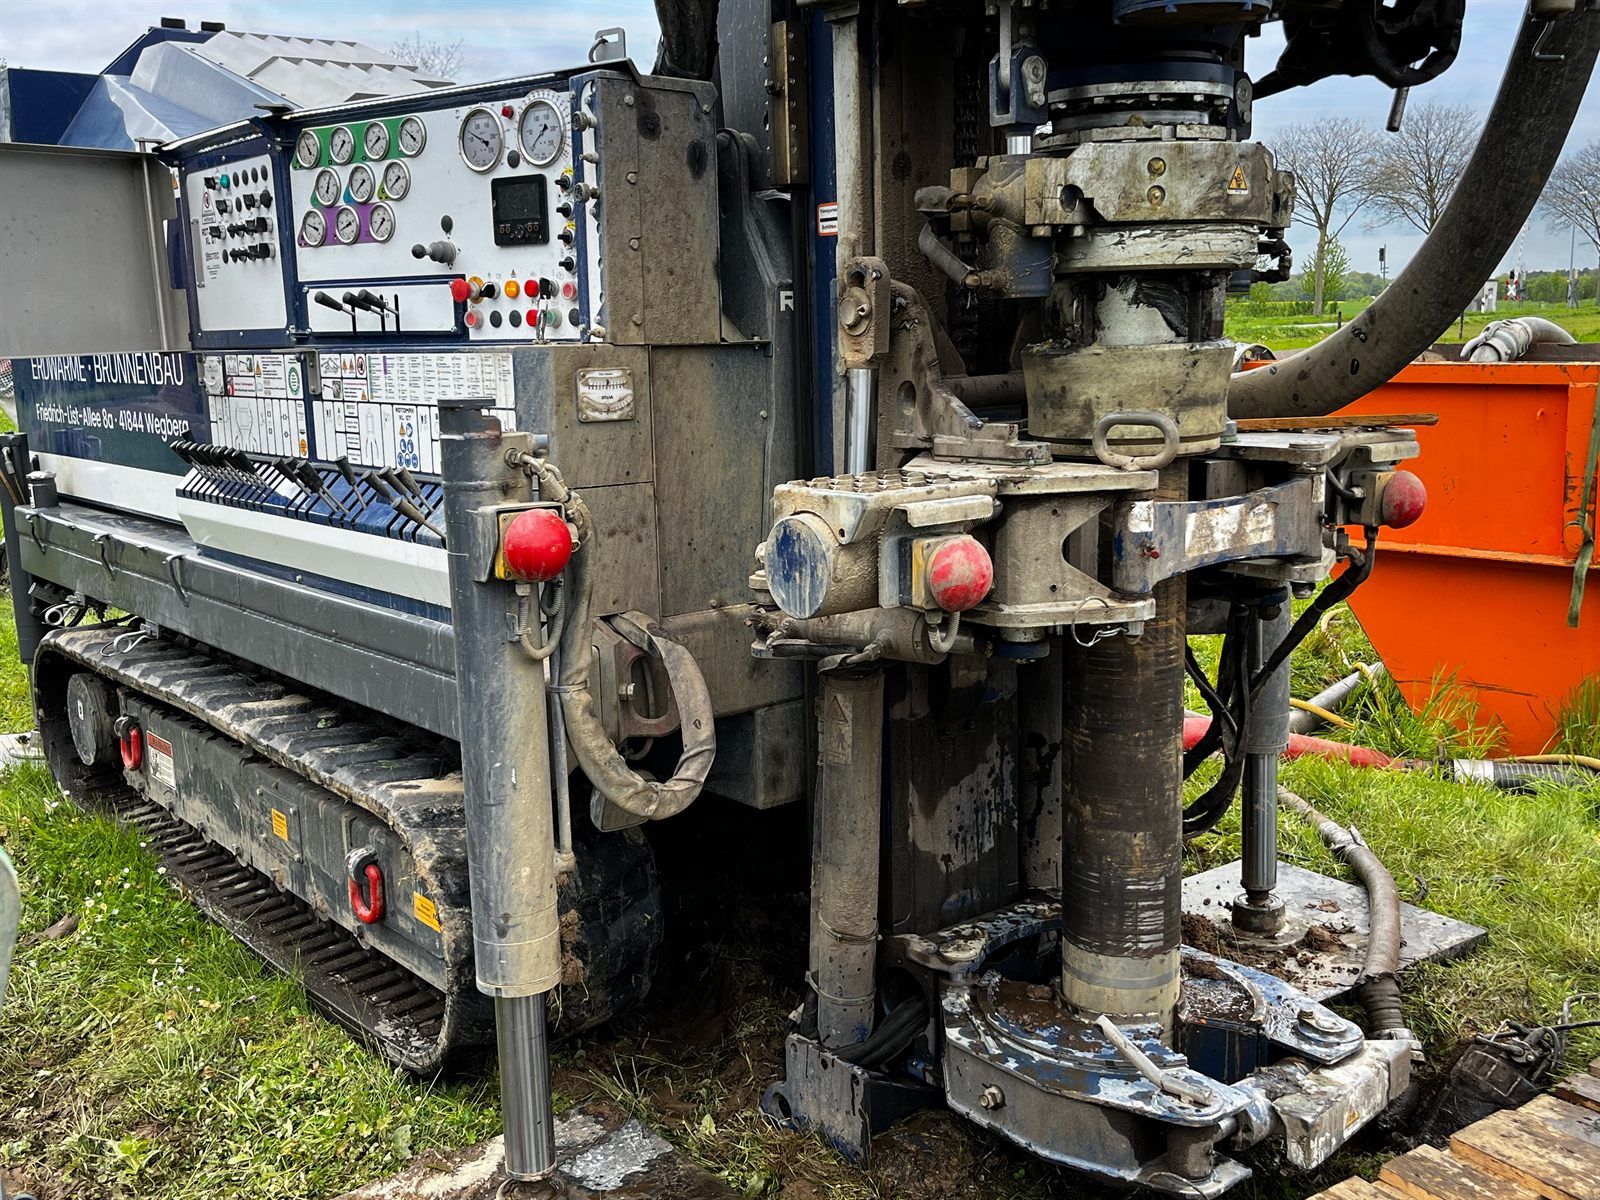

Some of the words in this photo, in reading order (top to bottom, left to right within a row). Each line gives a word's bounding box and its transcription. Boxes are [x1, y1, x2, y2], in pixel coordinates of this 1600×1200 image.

[780, 291, 794, 311] R
[93, 352, 184, 386] BRUNNENBAU
[35, 402, 101, 428] Friedrich-List-Allee
[101, 408, 114, 429] 8a
[119, 409, 144, 432] 41844
